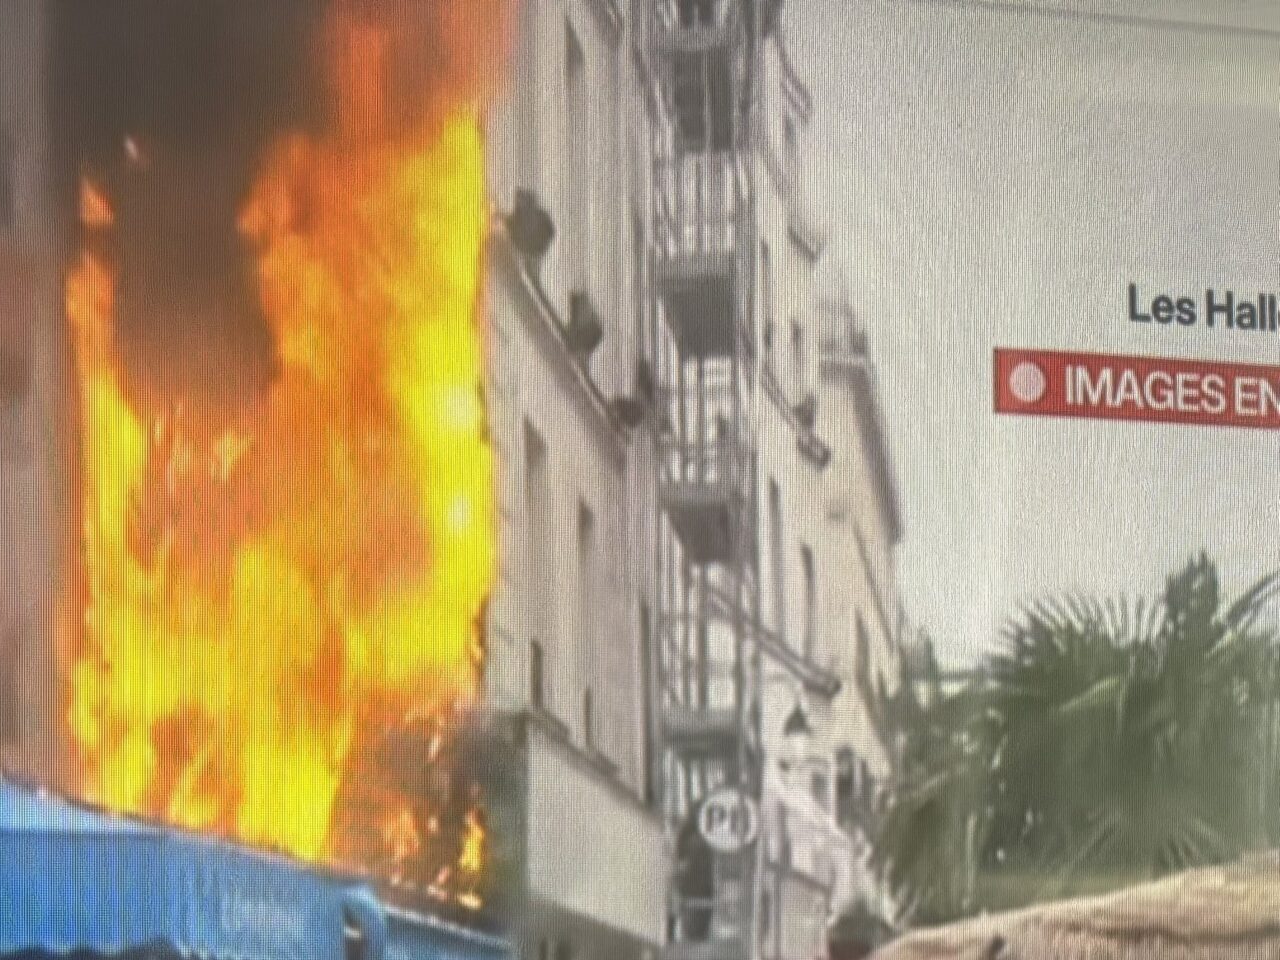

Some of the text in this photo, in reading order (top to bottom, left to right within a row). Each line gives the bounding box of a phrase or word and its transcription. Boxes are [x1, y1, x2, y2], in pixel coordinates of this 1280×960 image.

[1128, 283, 1280, 332] Les Hall
[1064, 364, 1227, 415] IMAGES
